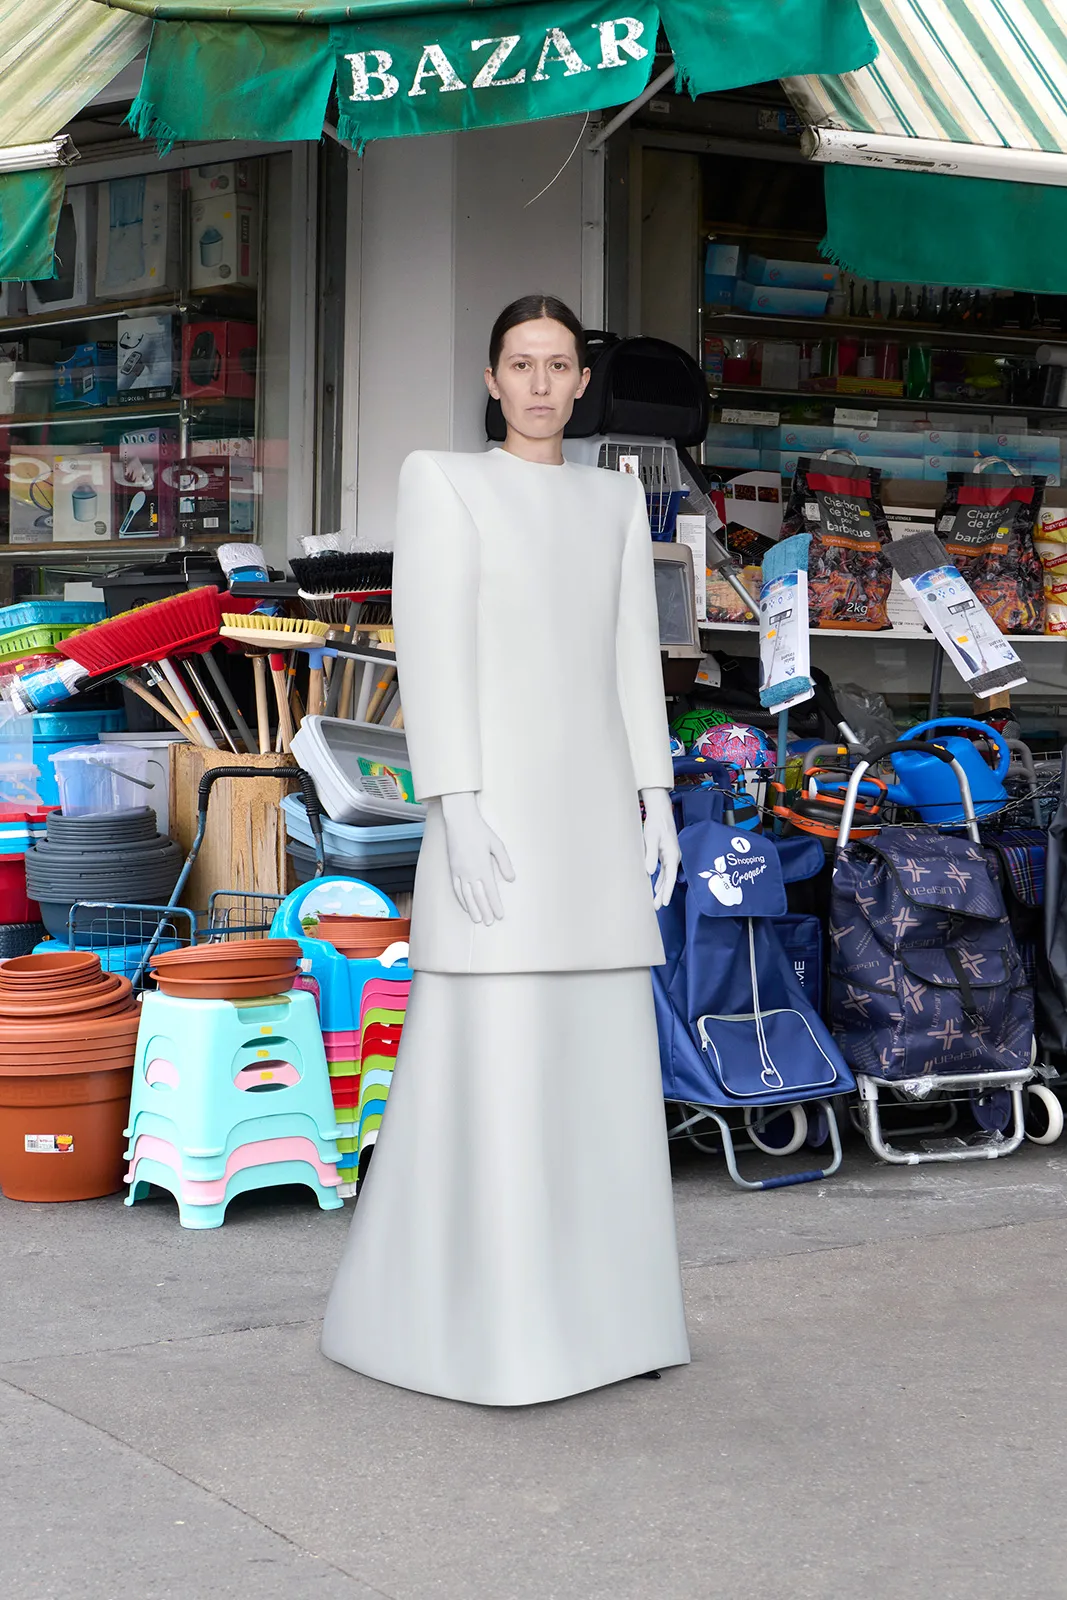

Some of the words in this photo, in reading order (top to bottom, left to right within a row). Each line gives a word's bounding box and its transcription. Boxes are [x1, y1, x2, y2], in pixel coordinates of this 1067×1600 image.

[344, 17, 648, 101] BAZAR
[823, 496, 861, 512] Charbon
[829, 507, 841, 517] de
[826, 521, 871, 538] barbecue
[967, 519, 984, 528] de
[846, 602, 868, 615] 2kg
[731, 863, 767, 885] Croquer
